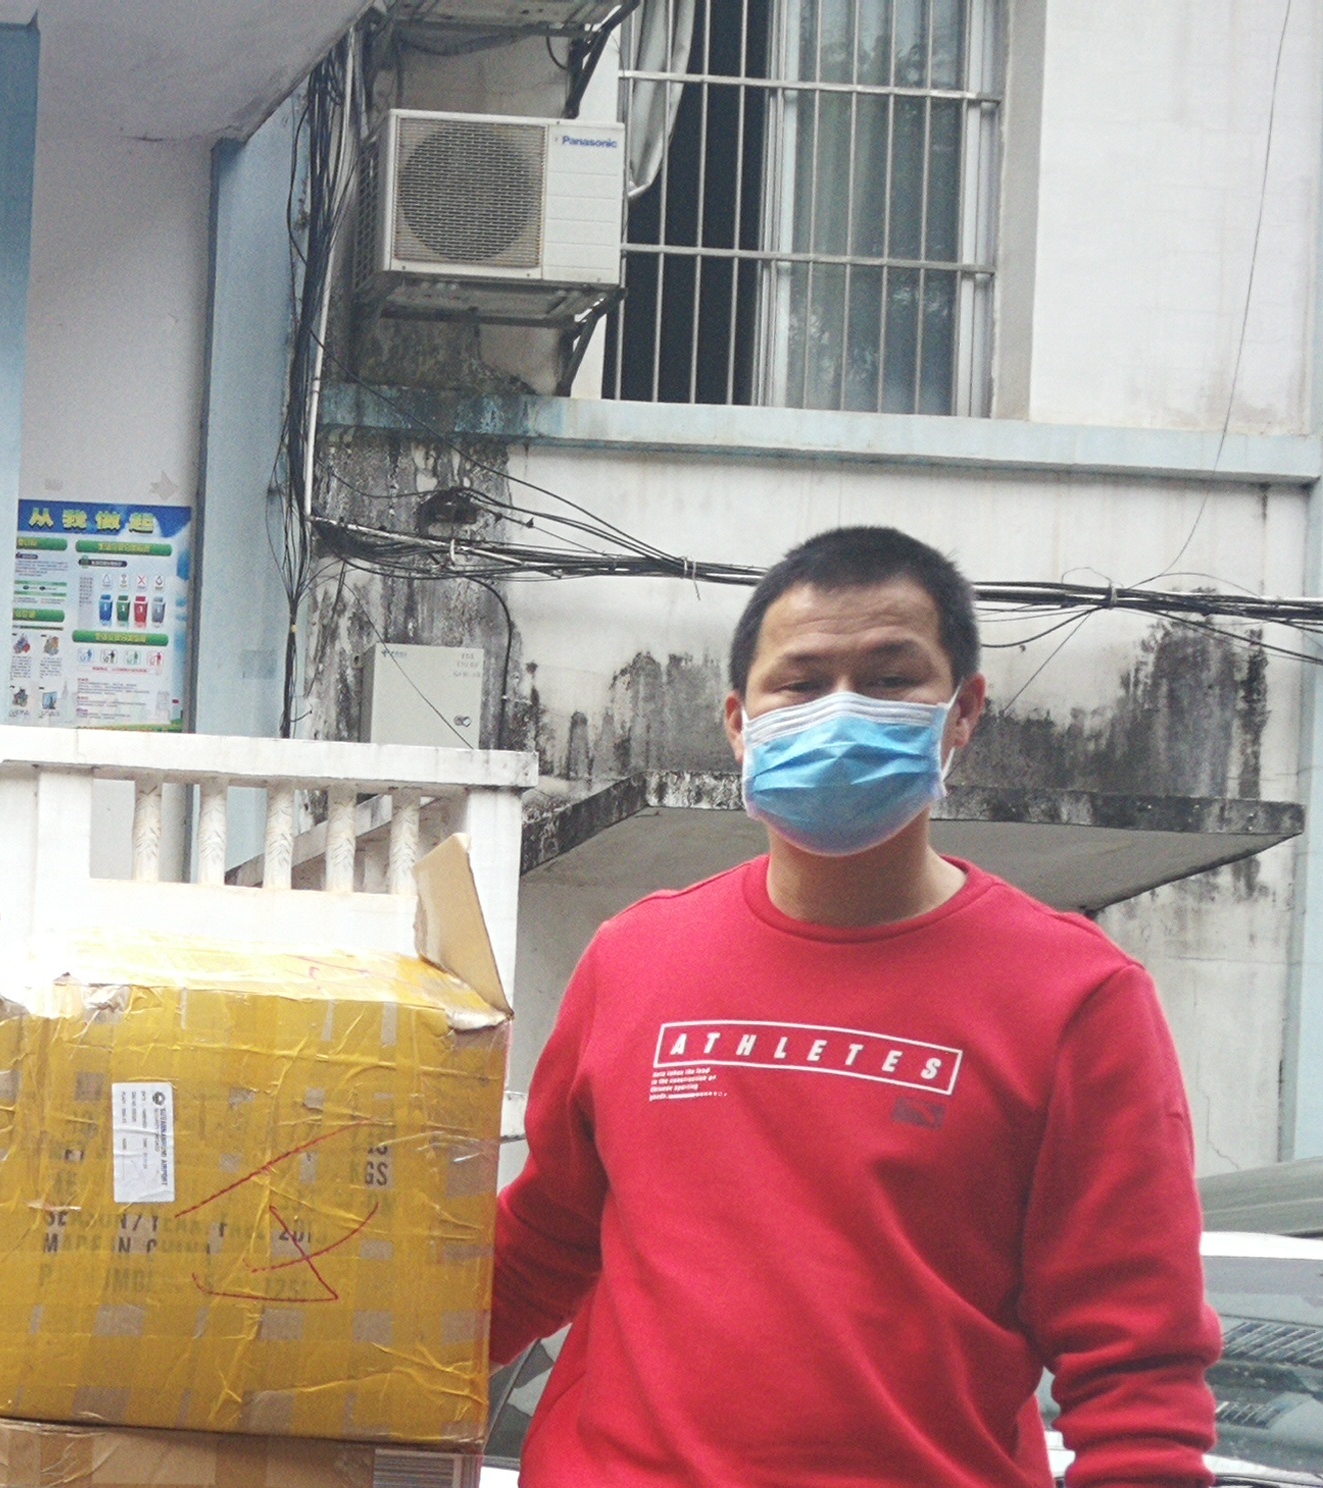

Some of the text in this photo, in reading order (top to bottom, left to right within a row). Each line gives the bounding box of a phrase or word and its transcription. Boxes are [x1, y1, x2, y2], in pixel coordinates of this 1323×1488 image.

[561, 134, 618, 149] Panasonic
[28, 507, 155, 533] 从我做起
[670, 1032, 943, 1081] ATHLETES
